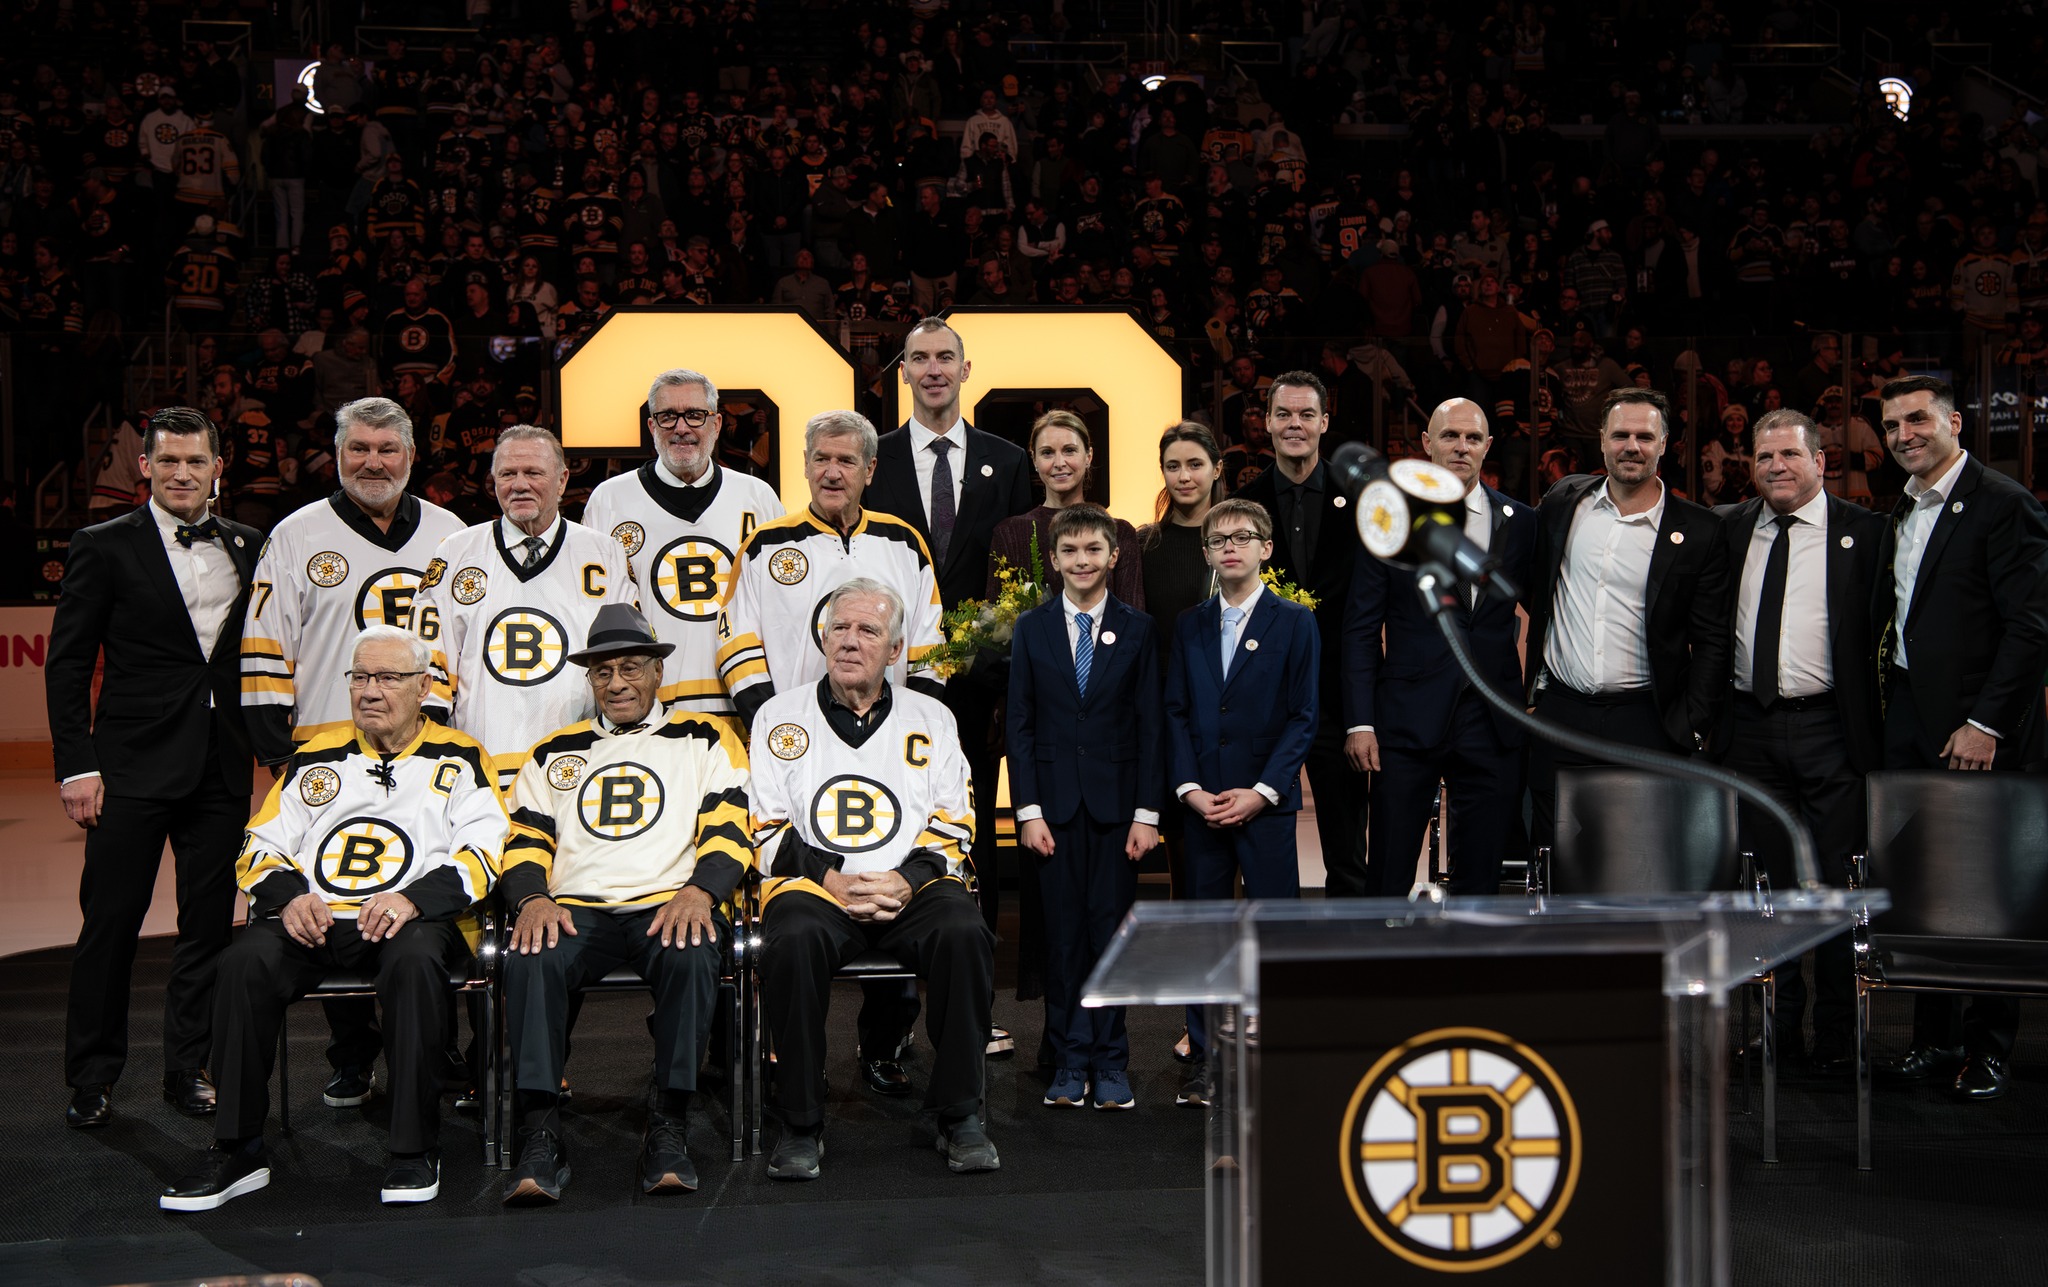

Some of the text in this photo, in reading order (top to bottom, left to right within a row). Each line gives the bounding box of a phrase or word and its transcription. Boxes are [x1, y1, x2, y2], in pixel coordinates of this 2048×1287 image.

[182, 147, 214, 175] 63
[180, 263, 220, 295] 30
[246, 428, 269, 445] 37
[623, 535, 633, 546] 33
[322, 564, 334, 576] 33
[582, 562, 606, 599] C
[675, 556, 718, 604] B
[783, 561, 794, 572] 33
[464, 580, 475, 592] 33
[717, 608, 733, 641] 4
[504, 622, 544, 672] B
[783, 737, 794, 747] 33
[904, 731, 932, 770] C
[313, 781, 324, 792] 33
[563, 768, 574, 778] 33
[599, 775, 646, 827] B
[835, 788, 877, 838] B
[336, 833, 388, 880] B
[1408, 1083, 1514, 1214] B
